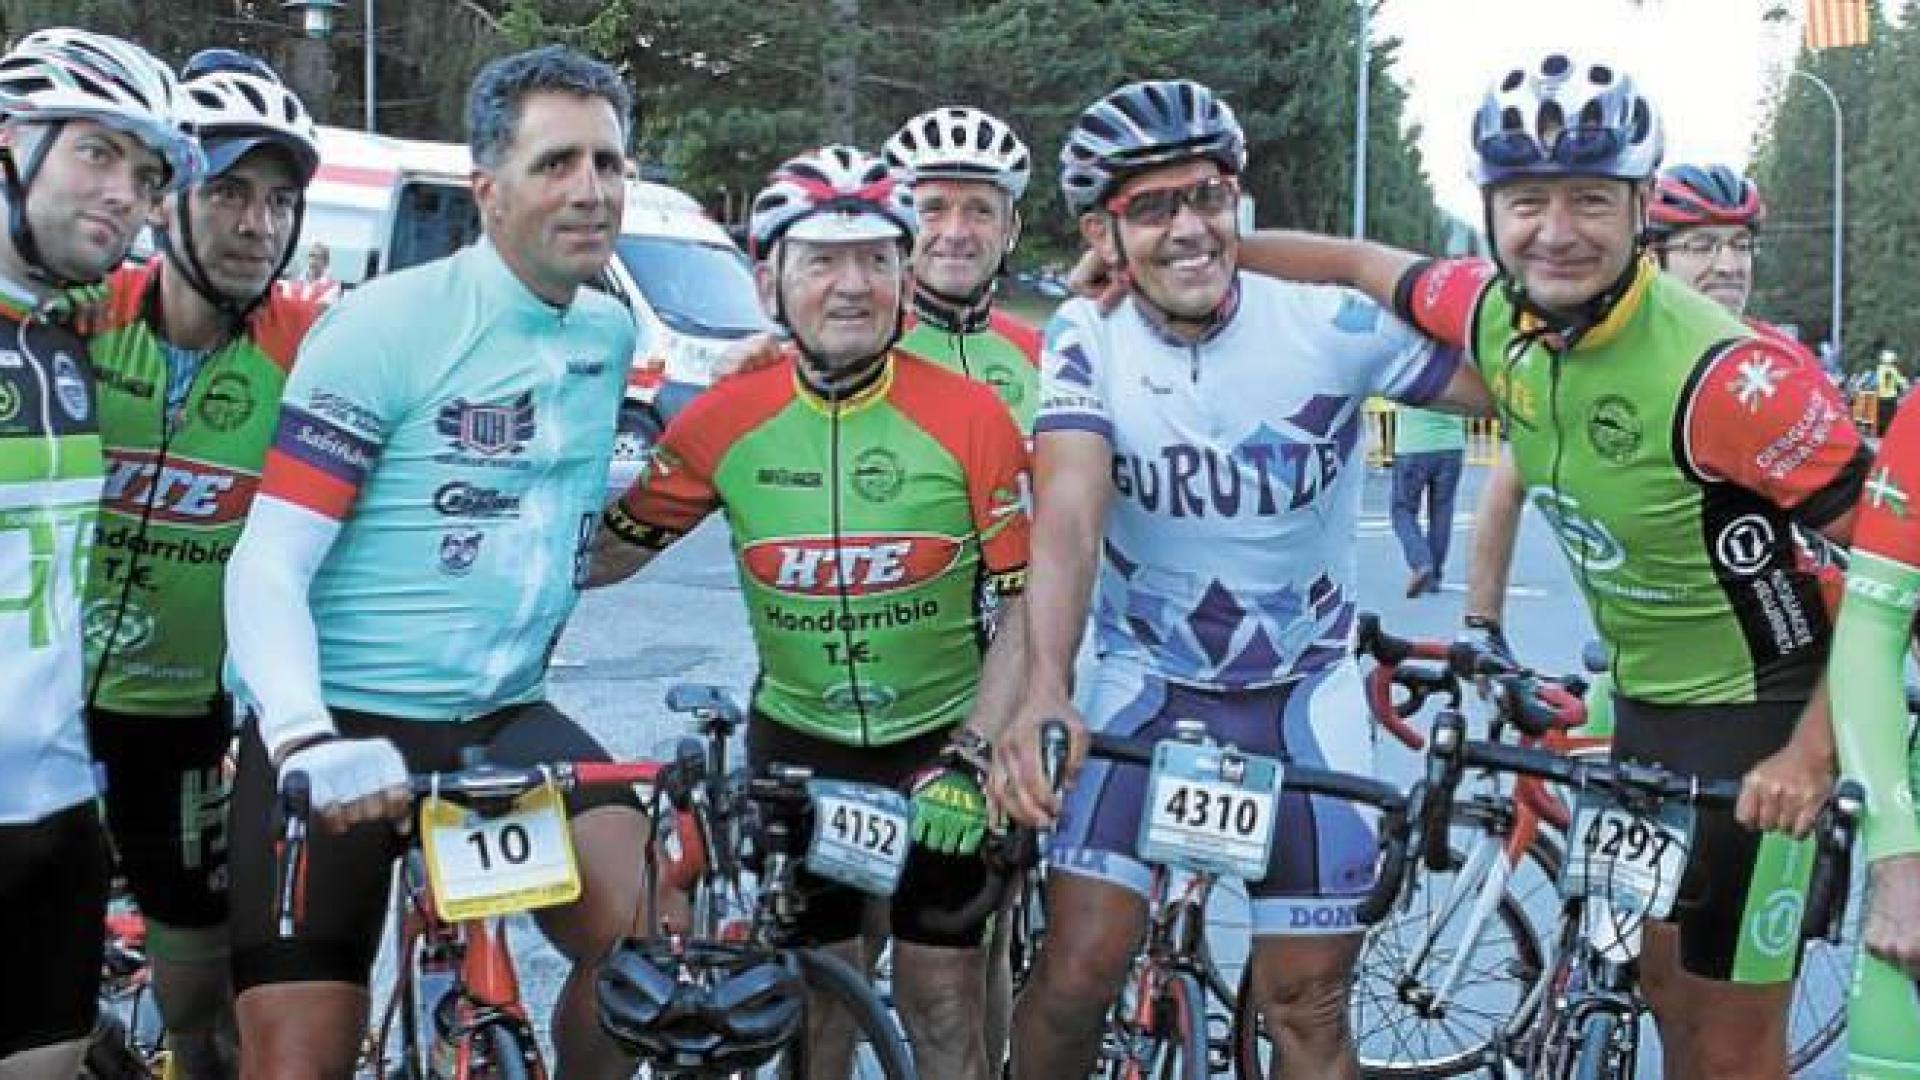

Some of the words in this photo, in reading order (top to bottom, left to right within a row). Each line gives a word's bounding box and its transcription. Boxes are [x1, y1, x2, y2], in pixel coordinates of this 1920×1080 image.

[1112, 442, 1342, 519] GURUTZE
[775, 540, 912, 588] HTE
[763, 598, 940, 634] Hondarribia
[830, 804, 898, 857] 4152
[1164, 785, 1257, 835] 4310
[466, 821, 532, 871] 10
